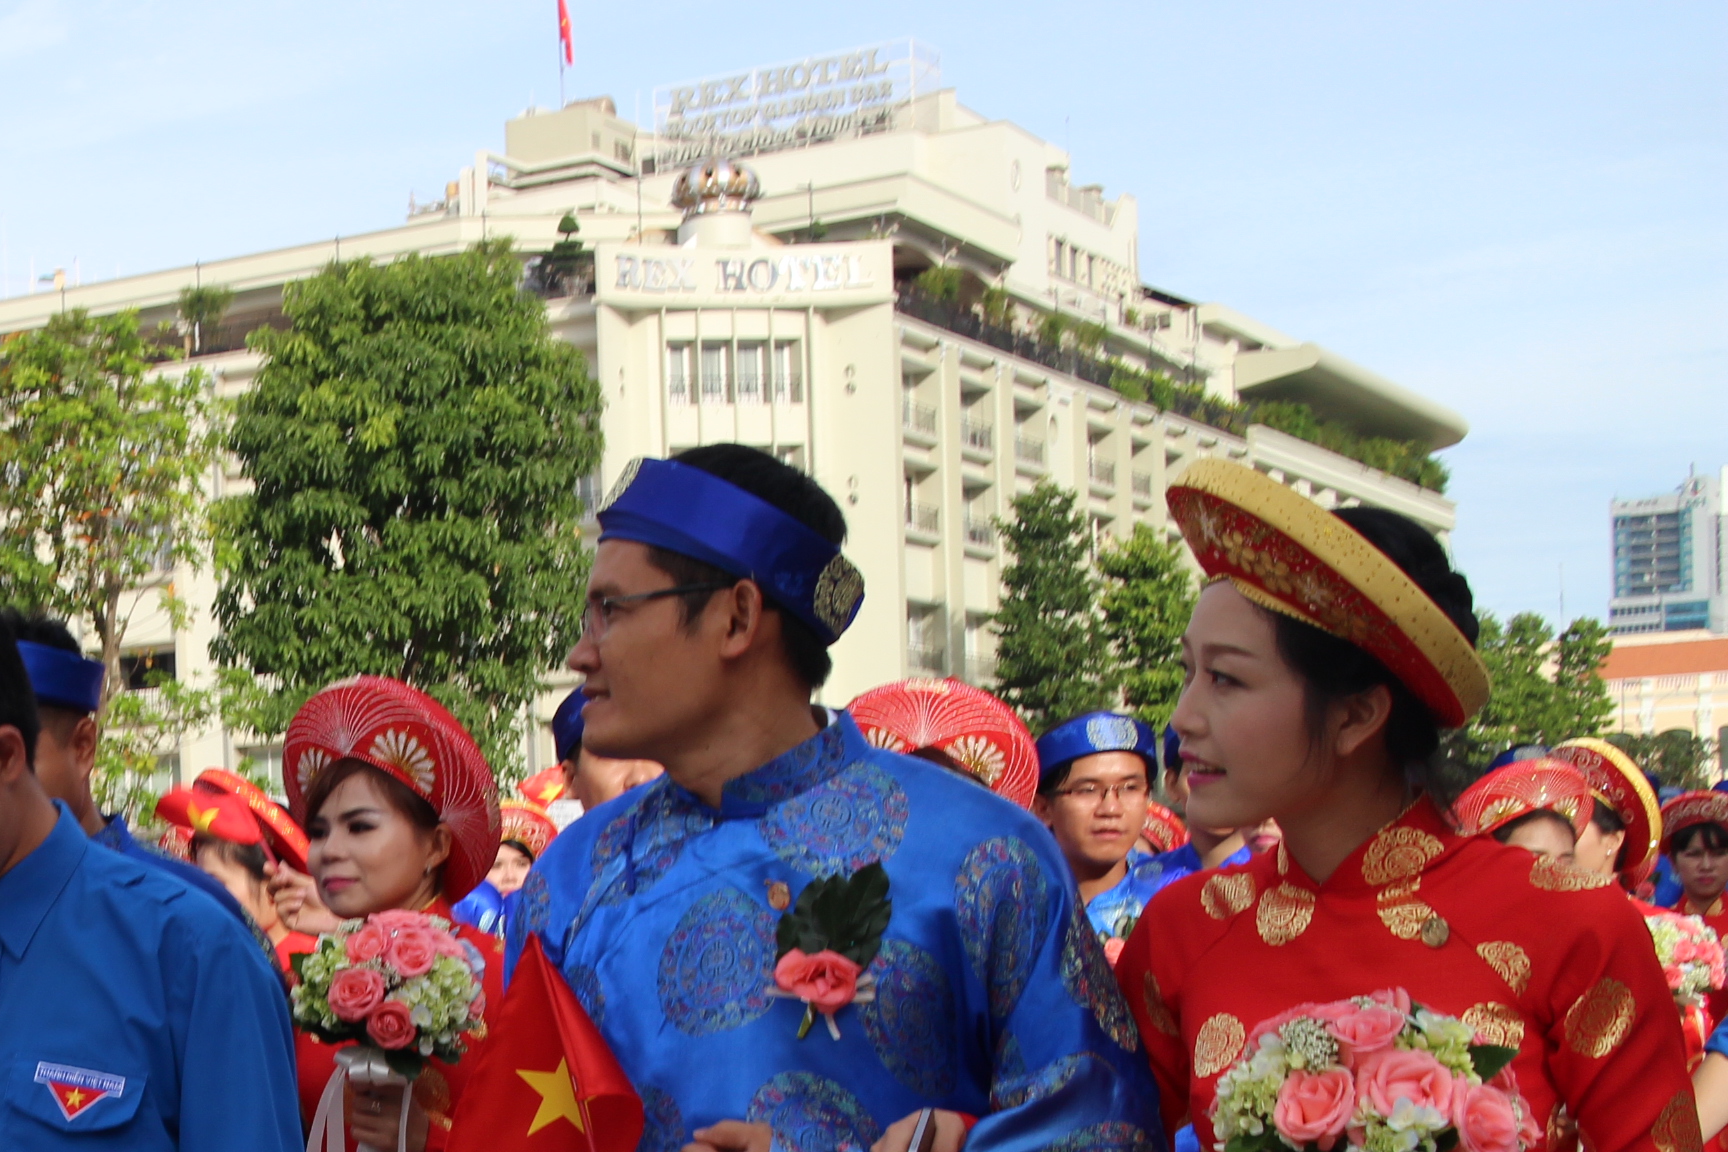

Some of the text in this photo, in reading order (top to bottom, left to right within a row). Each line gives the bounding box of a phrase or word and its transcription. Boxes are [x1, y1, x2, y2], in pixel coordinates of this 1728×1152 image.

[668, 48, 890, 117] REX HOTEL
[615, 253, 874, 294] REX HOTEL
